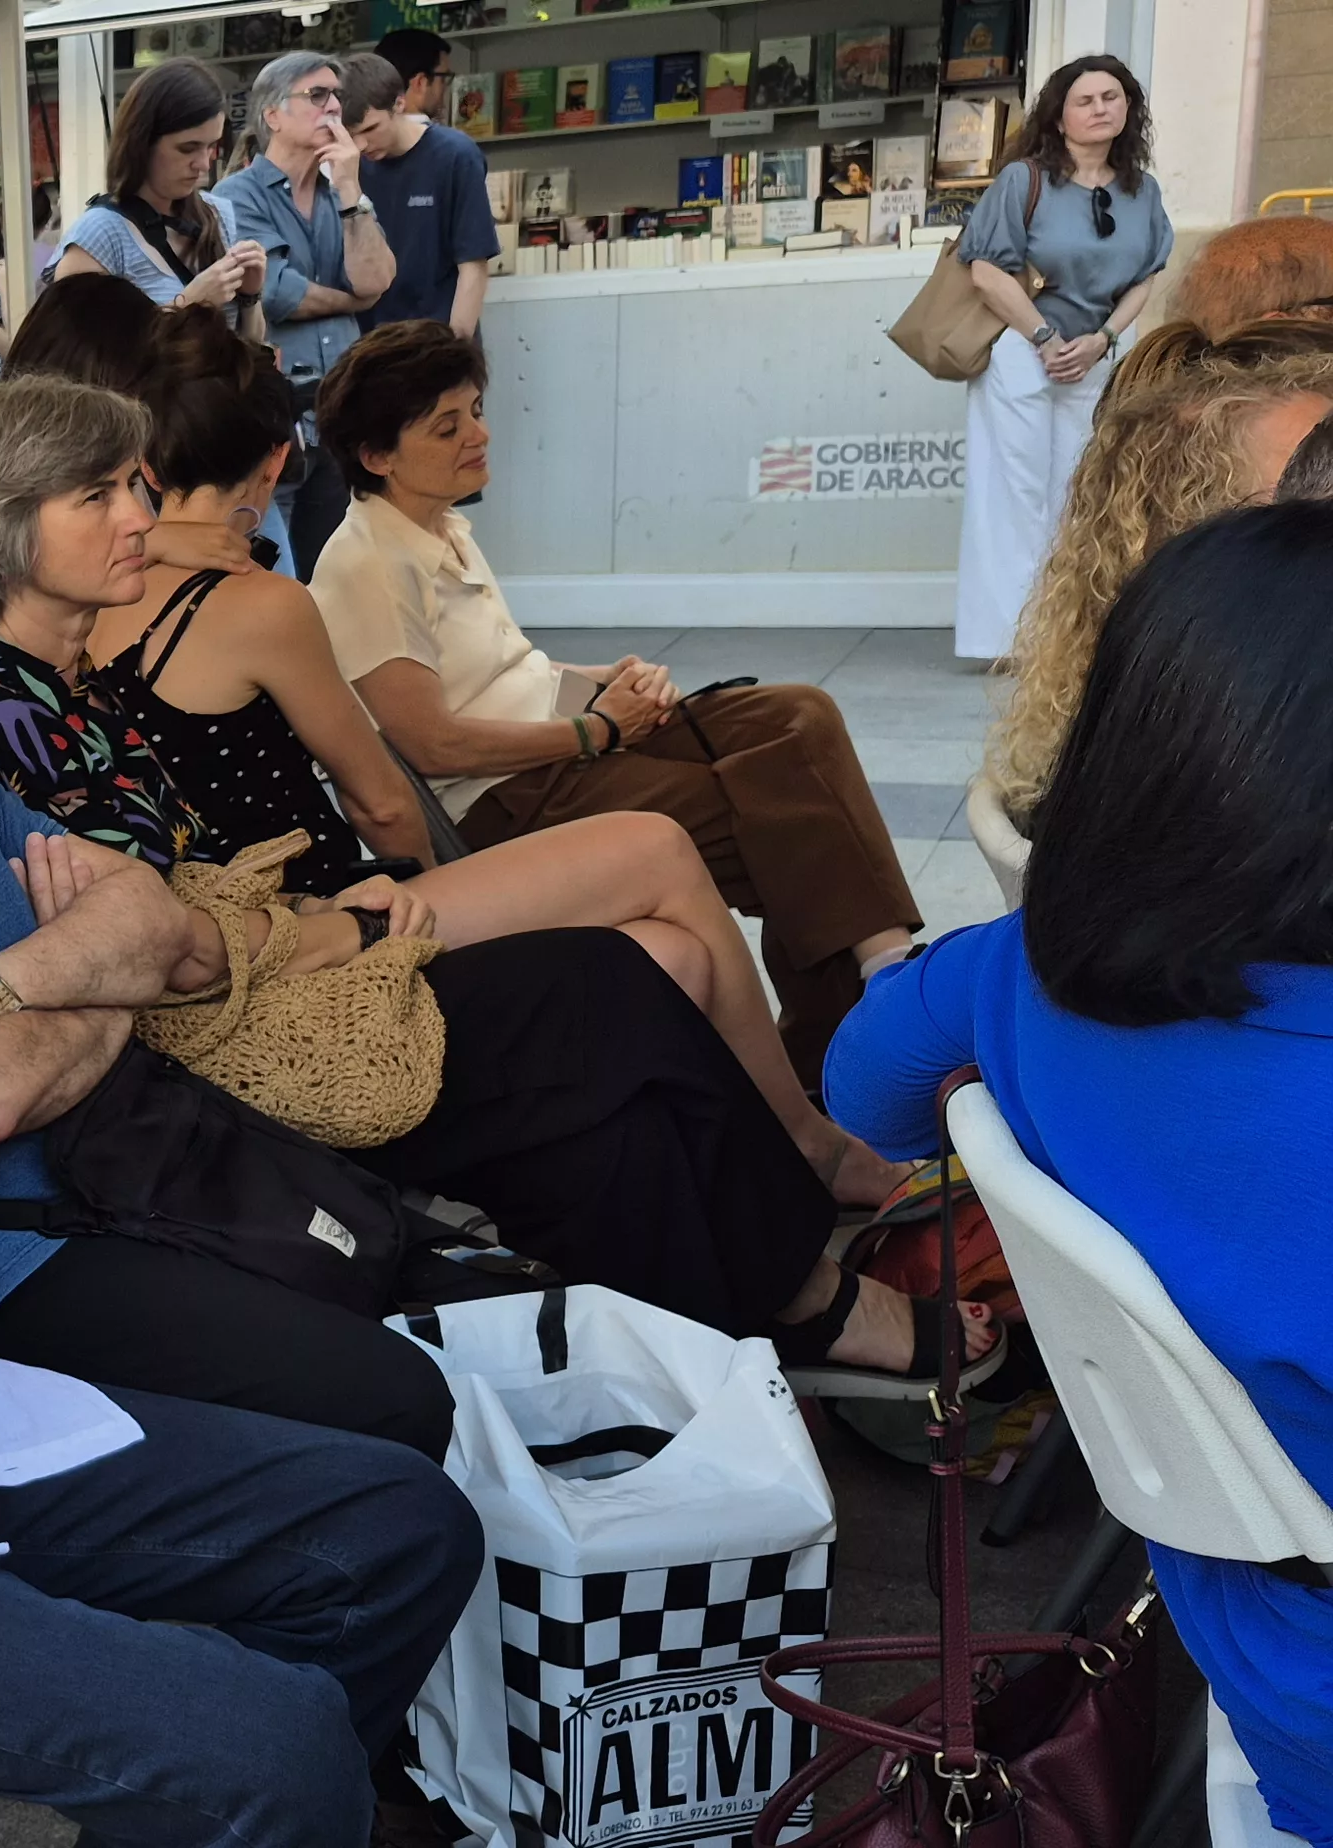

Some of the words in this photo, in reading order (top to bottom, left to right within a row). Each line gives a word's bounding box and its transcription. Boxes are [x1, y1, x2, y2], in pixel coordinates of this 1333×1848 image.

[816, 470, 854, 492] DE
[863, 466, 965, 492] ARAGO
[601, 1685, 738, 1729] CALZADOS
[599, 1818, 645, 1838] LORENZO,
[648, 1815, 660, 1827] 13
[690, 1806, 708, 1820] 974
[710, 1803, 724, 1816] 22
[725, 1801, 738, 1814] 91
[740, 1798, 754, 1811] 63
